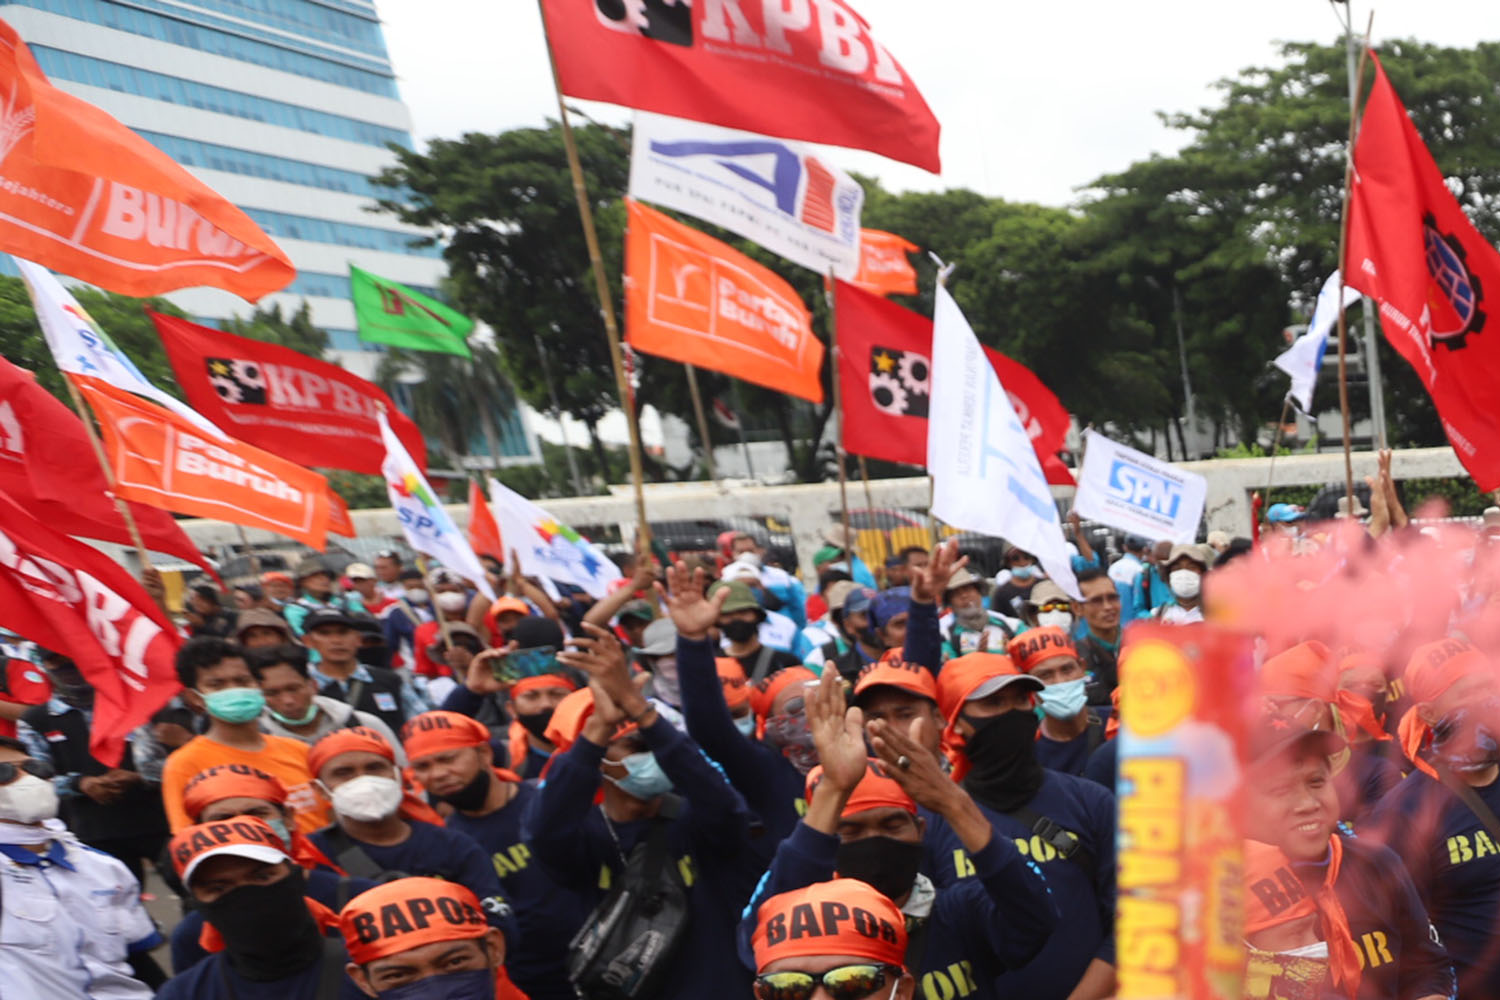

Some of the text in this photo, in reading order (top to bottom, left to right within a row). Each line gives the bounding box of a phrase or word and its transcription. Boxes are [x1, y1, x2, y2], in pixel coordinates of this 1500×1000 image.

[701, 0, 904, 84] KPBI
[264, 362, 386, 420] KPBI
[1111, 462, 1181, 517] SPN
[355, 896, 484, 945] BAPOR
[766, 901, 898, 947] BAPOR
